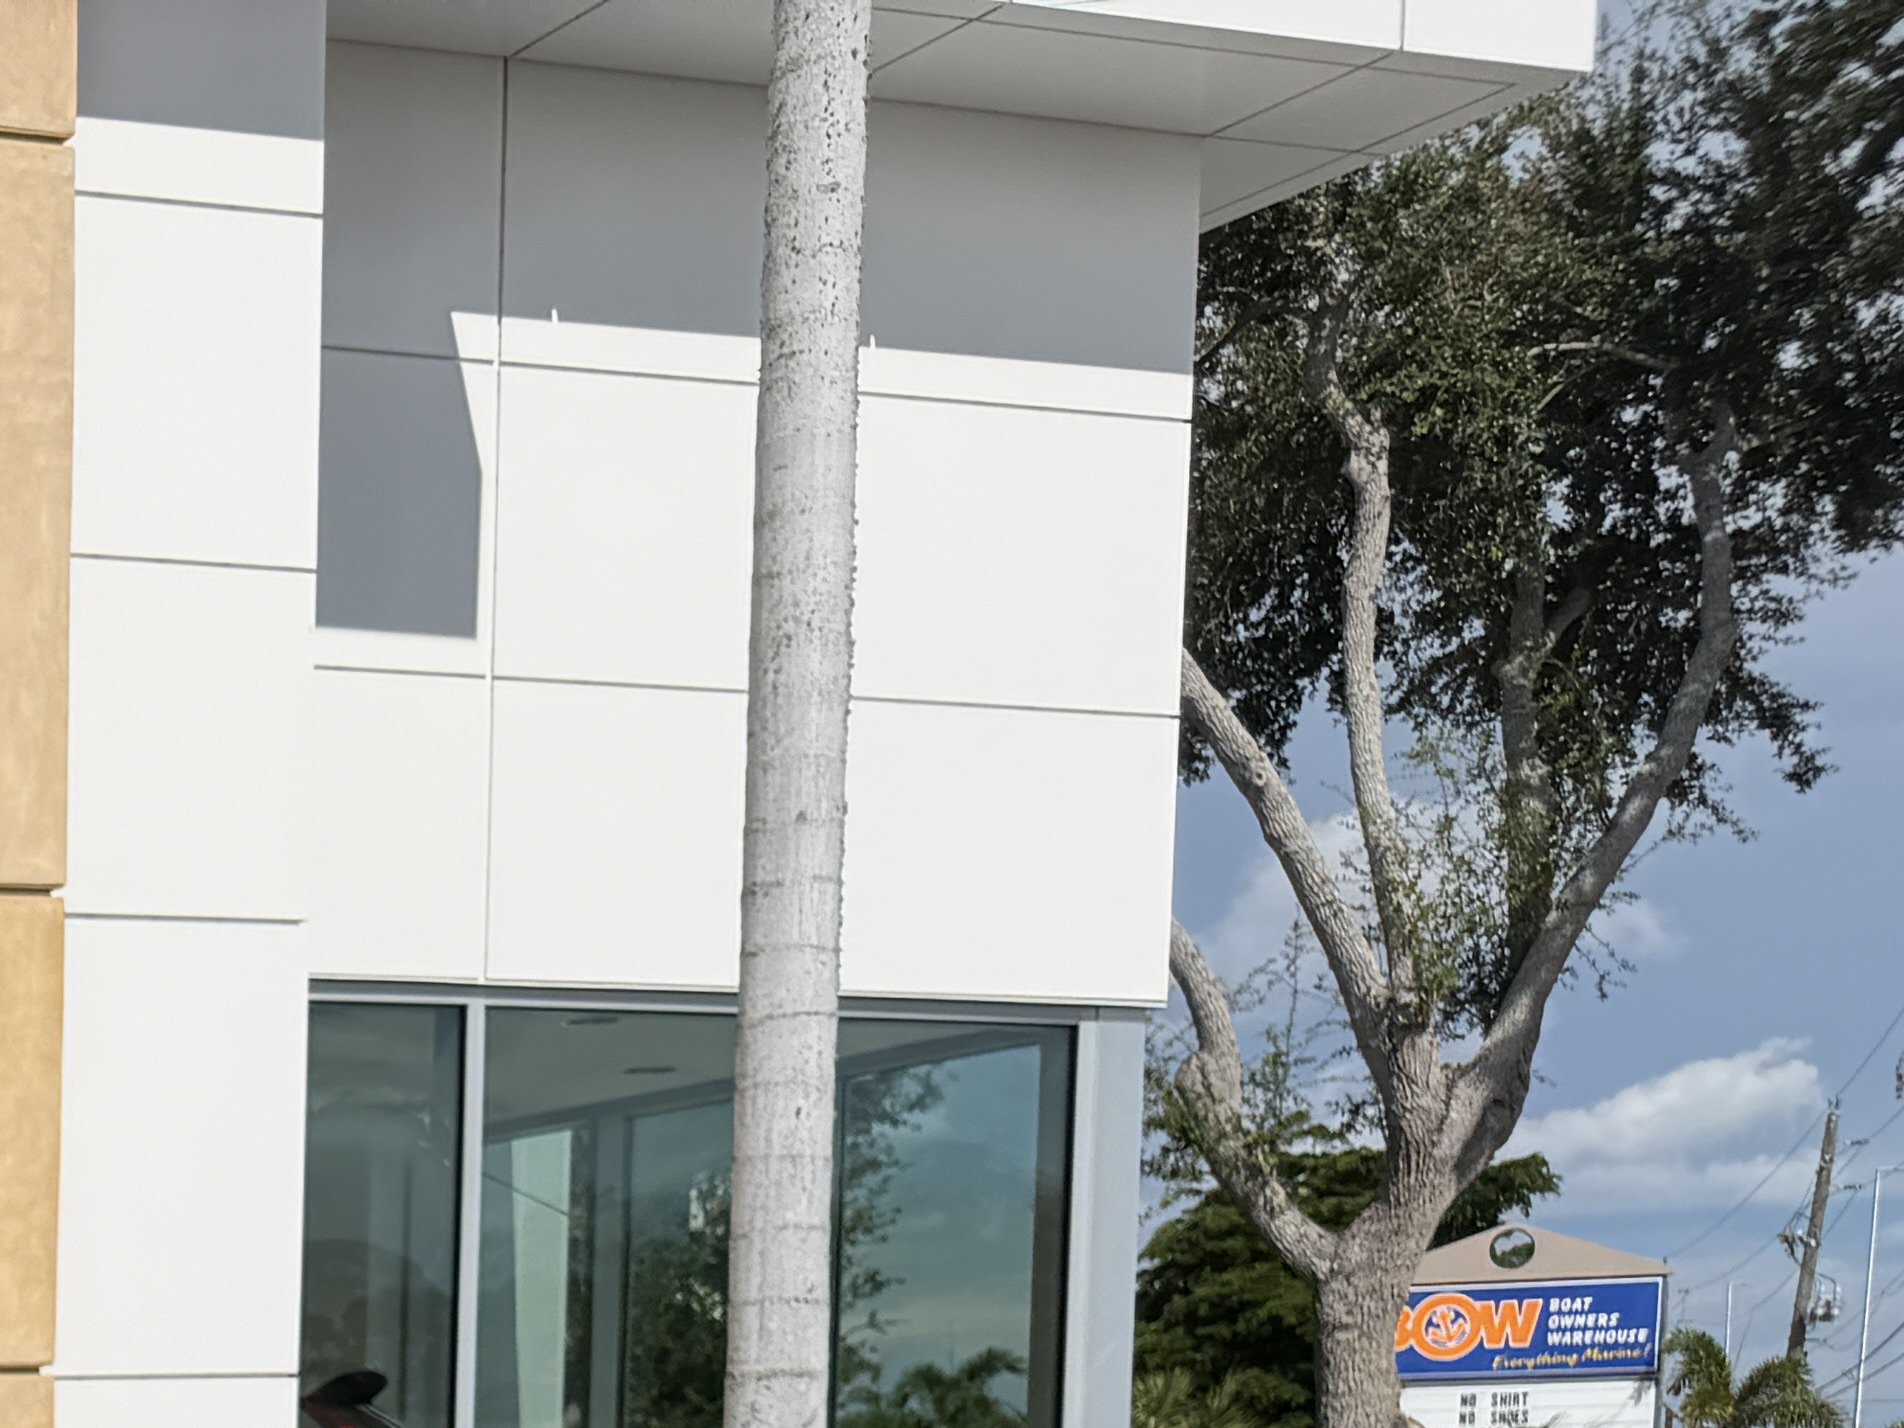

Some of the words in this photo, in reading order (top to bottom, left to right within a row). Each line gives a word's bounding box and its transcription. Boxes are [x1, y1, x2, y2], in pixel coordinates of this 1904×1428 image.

[1549, 1297, 1593, 1313] BOAT
[1548, 1312, 1620, 1329] OWNERS
[1547, 1328, 1649, 1346] WAREHOUSE
[1460, 1392, 1477, 1407] NO
[1491, 1391, 1529, 1407] SHIRT
[1459, 1410, 1476, 1425] NO
[1490, 1409, 1529, 1425] SHOES
